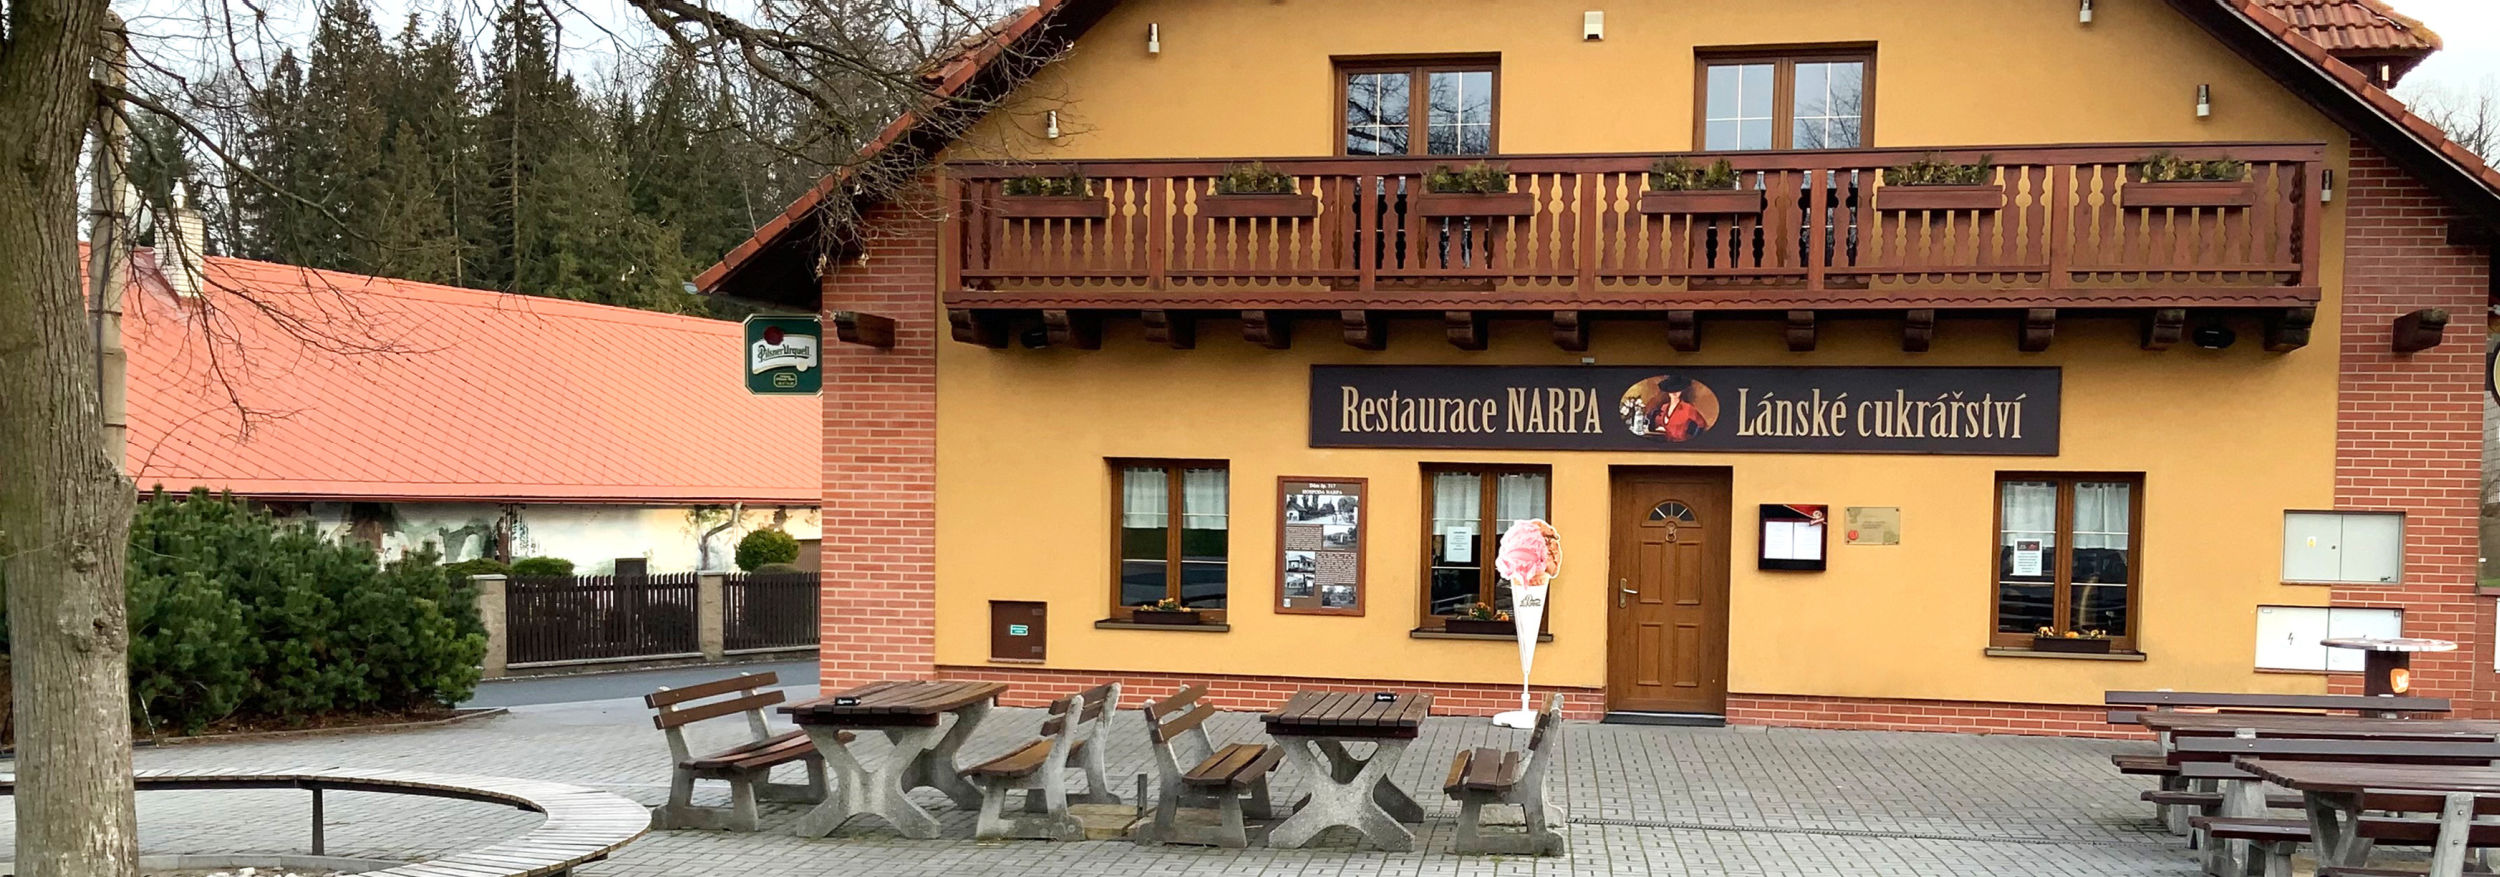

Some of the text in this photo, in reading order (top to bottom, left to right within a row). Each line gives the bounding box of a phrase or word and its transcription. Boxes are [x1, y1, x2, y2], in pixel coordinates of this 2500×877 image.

[757, 343, 810, 362] Pilsner Urquell
[1340, 385, 1603, 434] Restaurace NARPA
[1736, 387, 2027, 439] Lánské cukrářství
